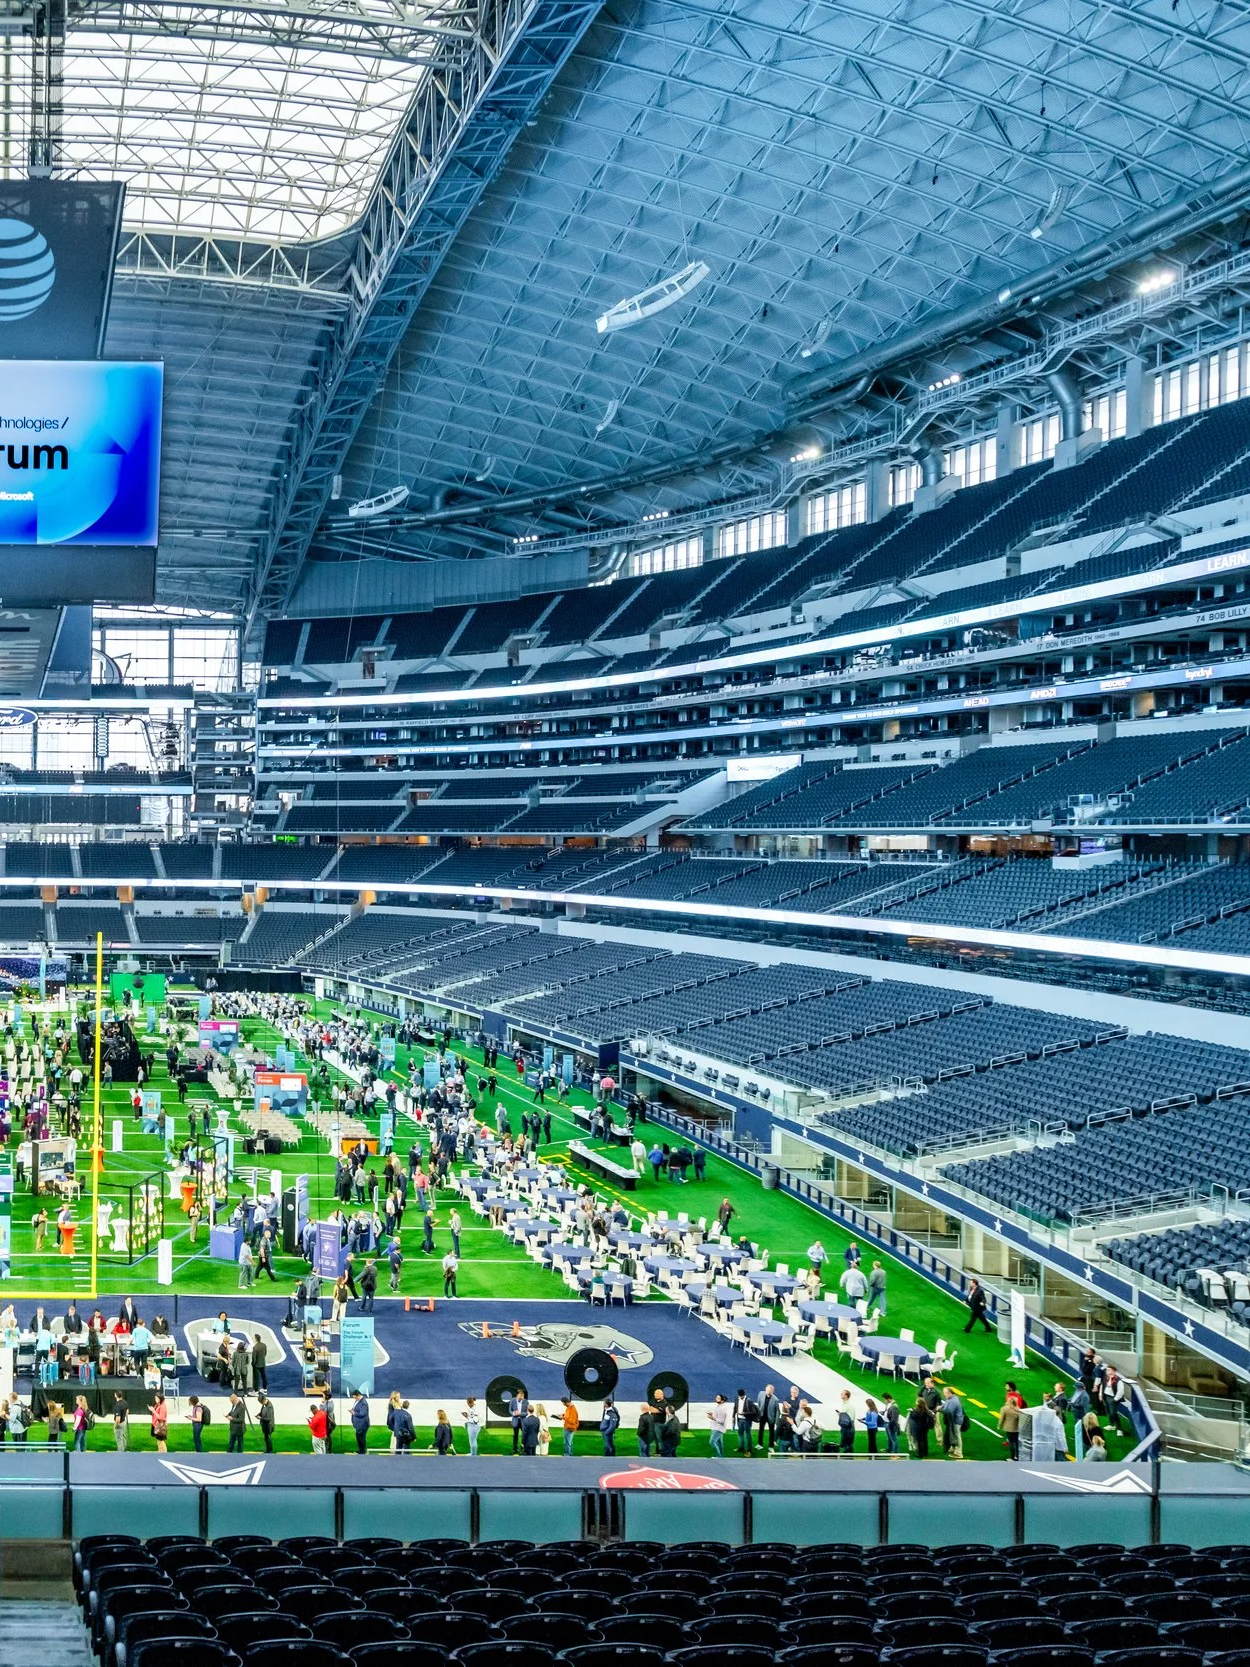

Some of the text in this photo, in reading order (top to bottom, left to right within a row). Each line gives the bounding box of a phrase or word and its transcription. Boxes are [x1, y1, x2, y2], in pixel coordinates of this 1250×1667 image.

[1196, 607, 1248, 624] 74 BOB LILLY
[1036, 643, 1043, 651] 17
[1046, 641, 1059, 649] DON
[1061, 636, 1093, 647] MEREDITH
